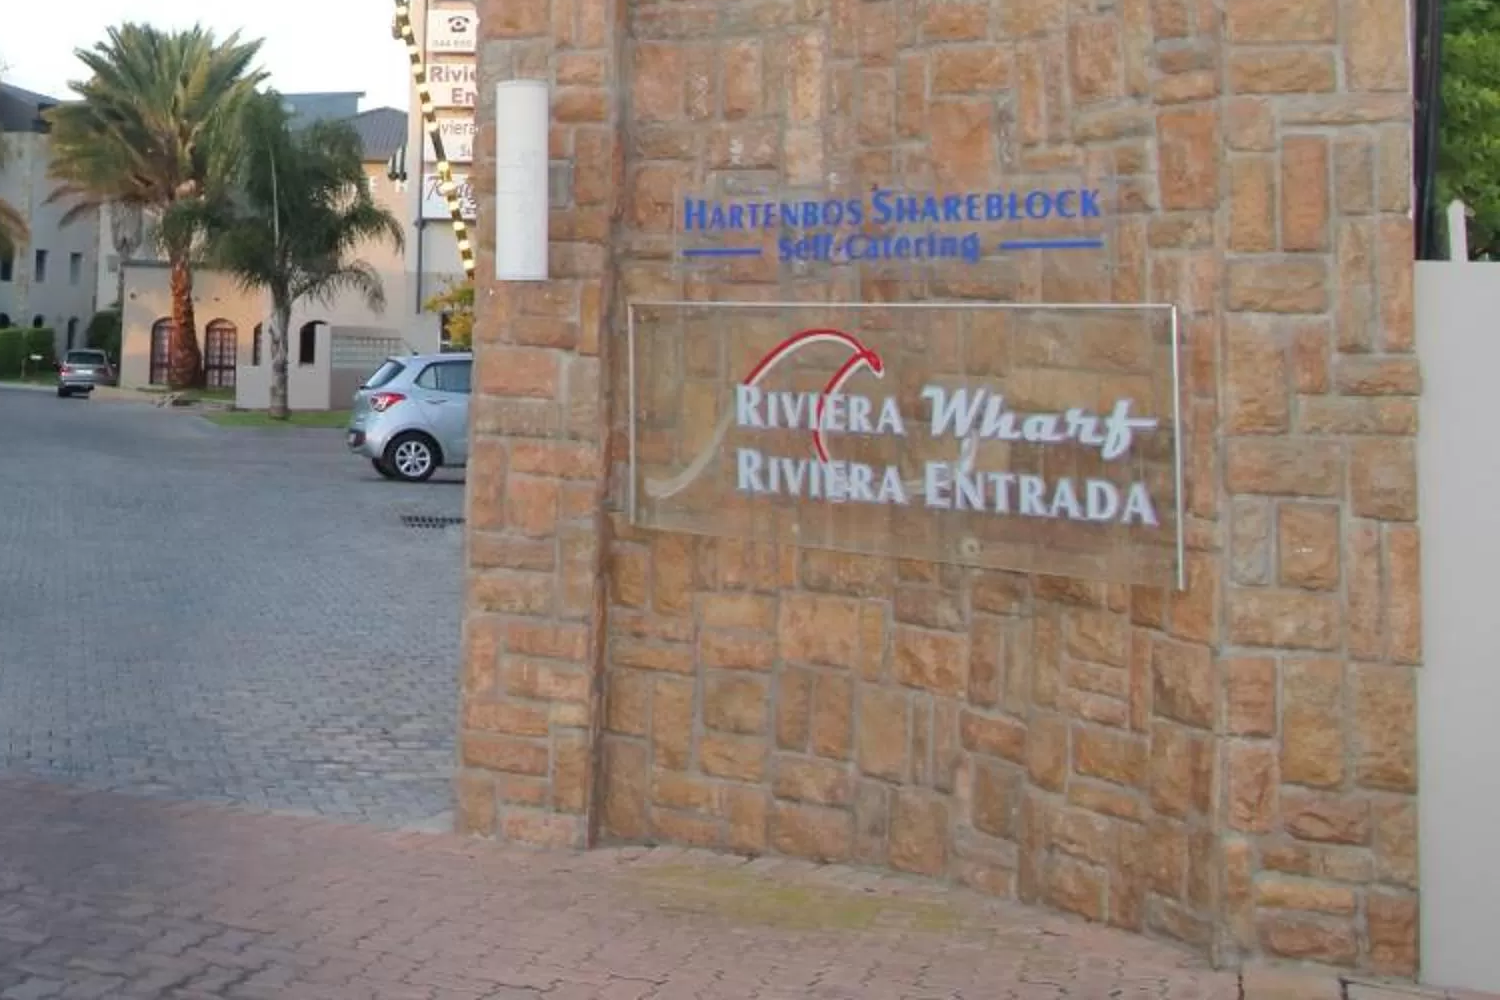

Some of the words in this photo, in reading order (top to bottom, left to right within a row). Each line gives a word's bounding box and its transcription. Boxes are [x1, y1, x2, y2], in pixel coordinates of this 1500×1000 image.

[684, 196, 864, 231] HARTENBOS
[871, 187, 1100, 224] SHAREBLOCK
[778, 231, 981, 264] Self-Catering
[736, 384, 907, 435] RIVIERA
[921, 385, 1159, 460] Wharf
[736, 448, 909, 506] RIVIERA
[924, 460, 1160, 527] ENTRADA
